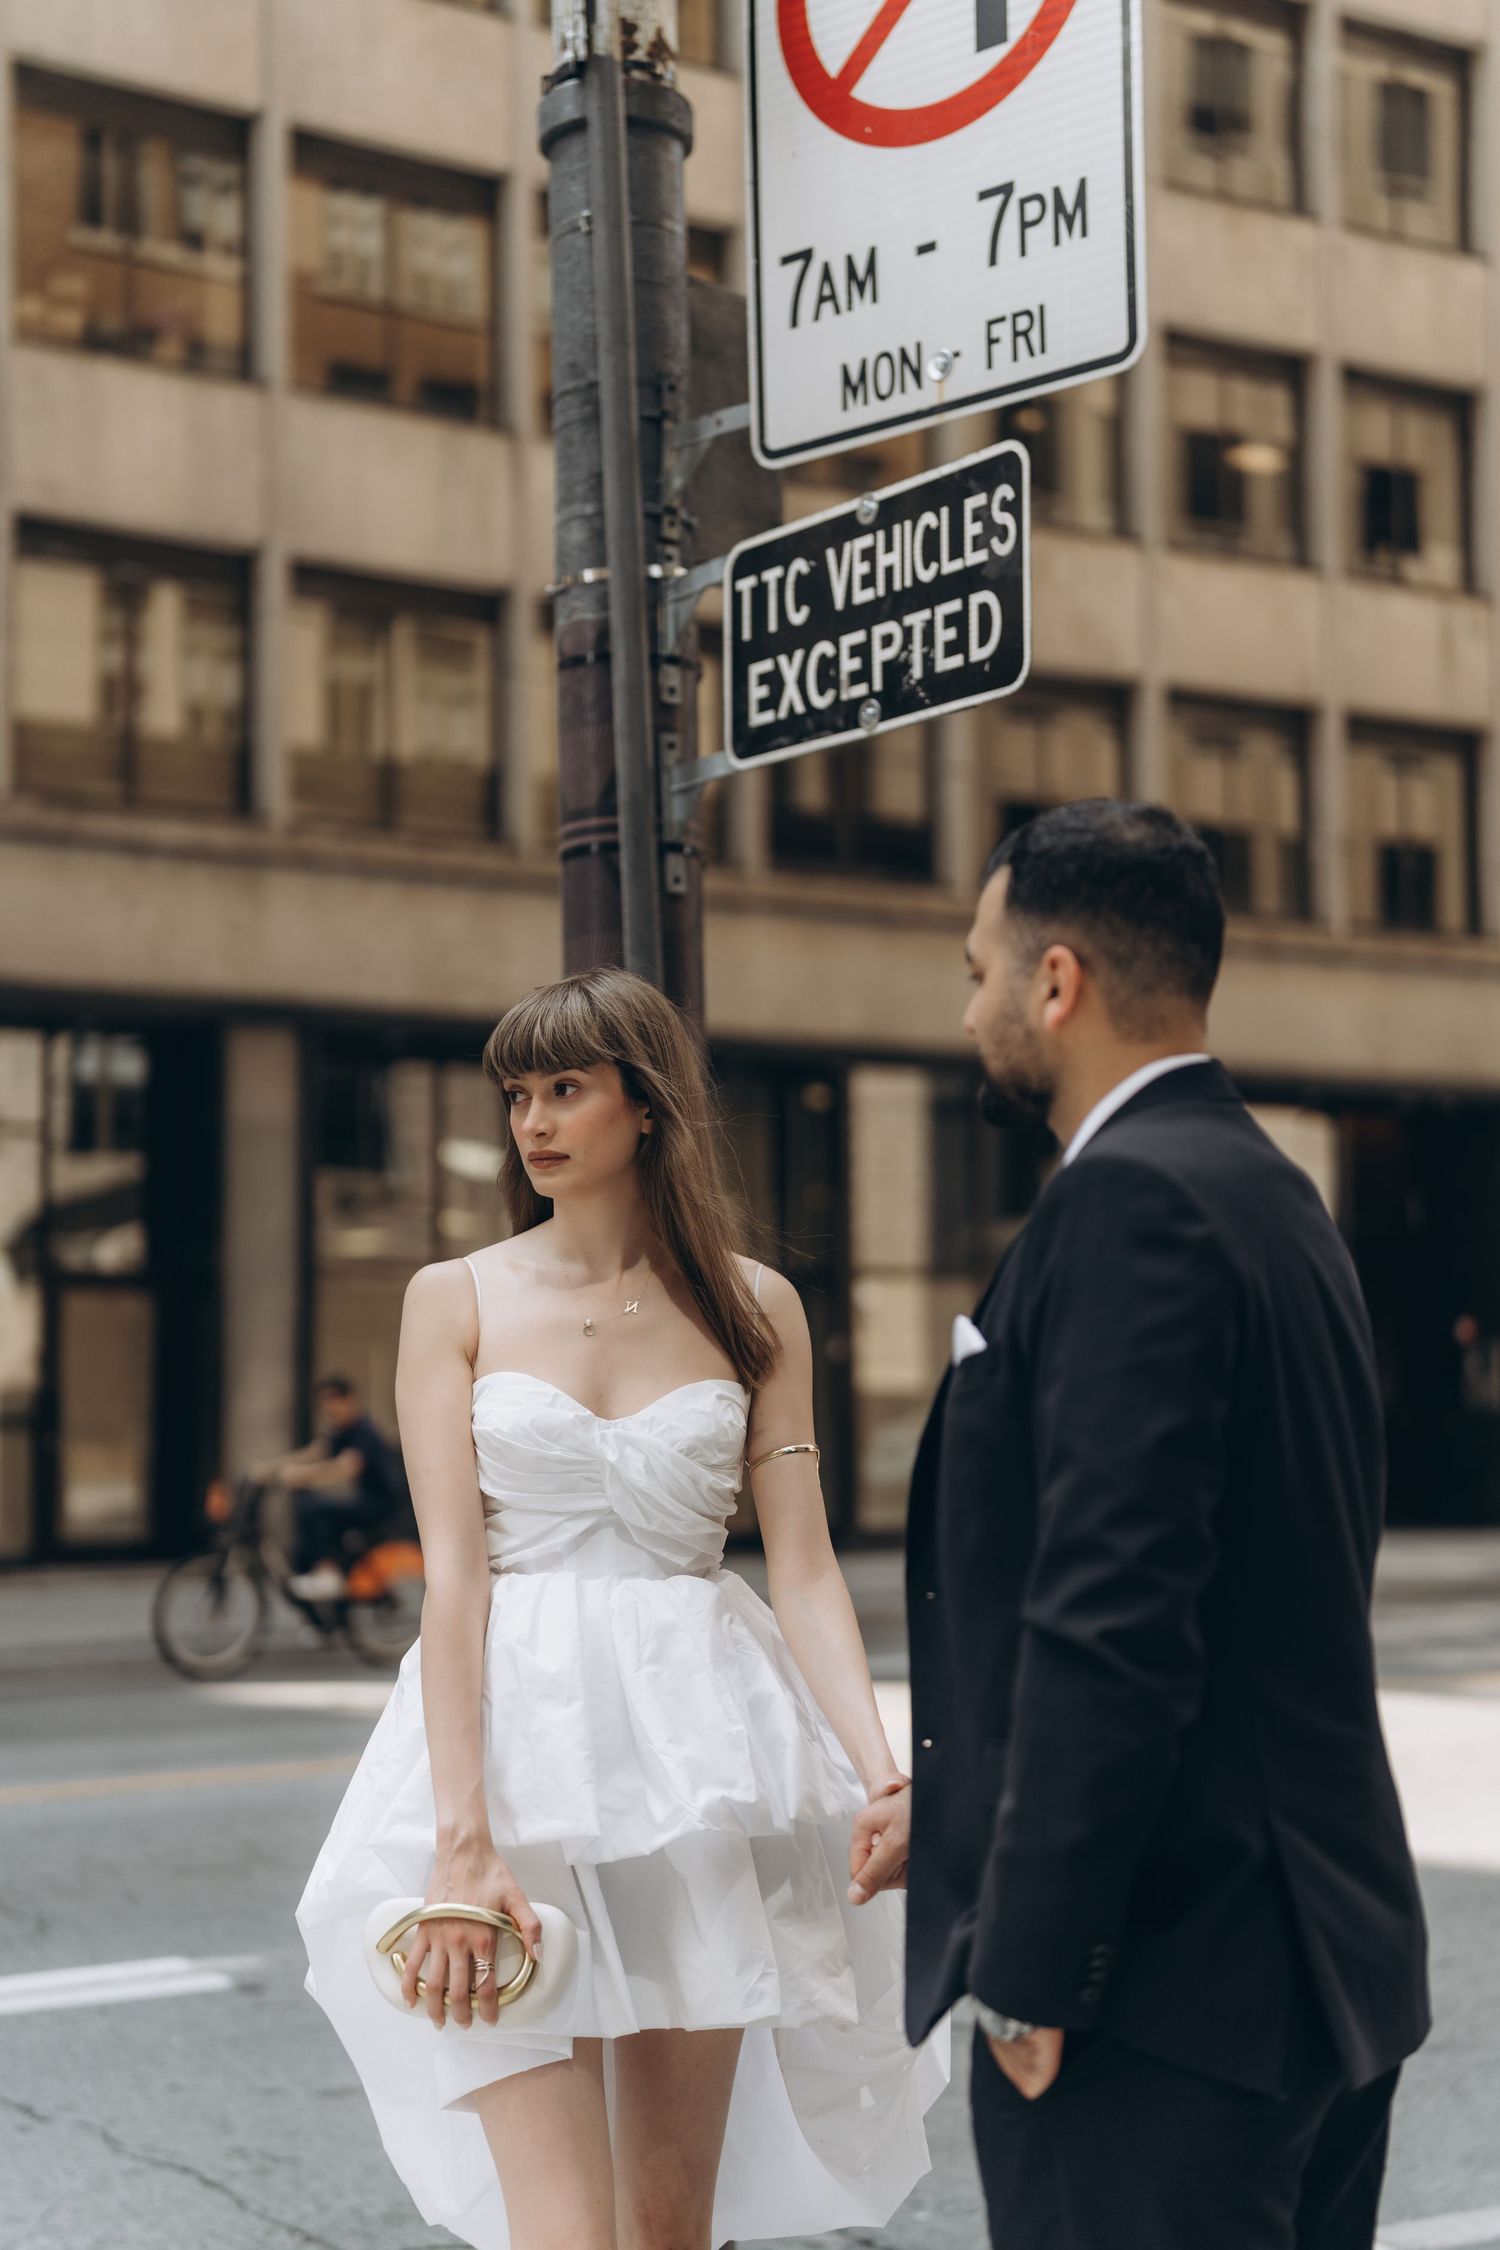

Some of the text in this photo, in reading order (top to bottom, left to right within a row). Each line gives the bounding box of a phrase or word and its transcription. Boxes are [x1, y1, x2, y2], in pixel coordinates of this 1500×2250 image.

[780, 176, 1089, 329] 7AM - 7PM
[840, 341, 923, 412] MON
[985, 303, 1047, 370] FRI
[735, 483, 1017, 642] TTC VEHICLES
[747, 589, 1003, 729] EXCEPTED
